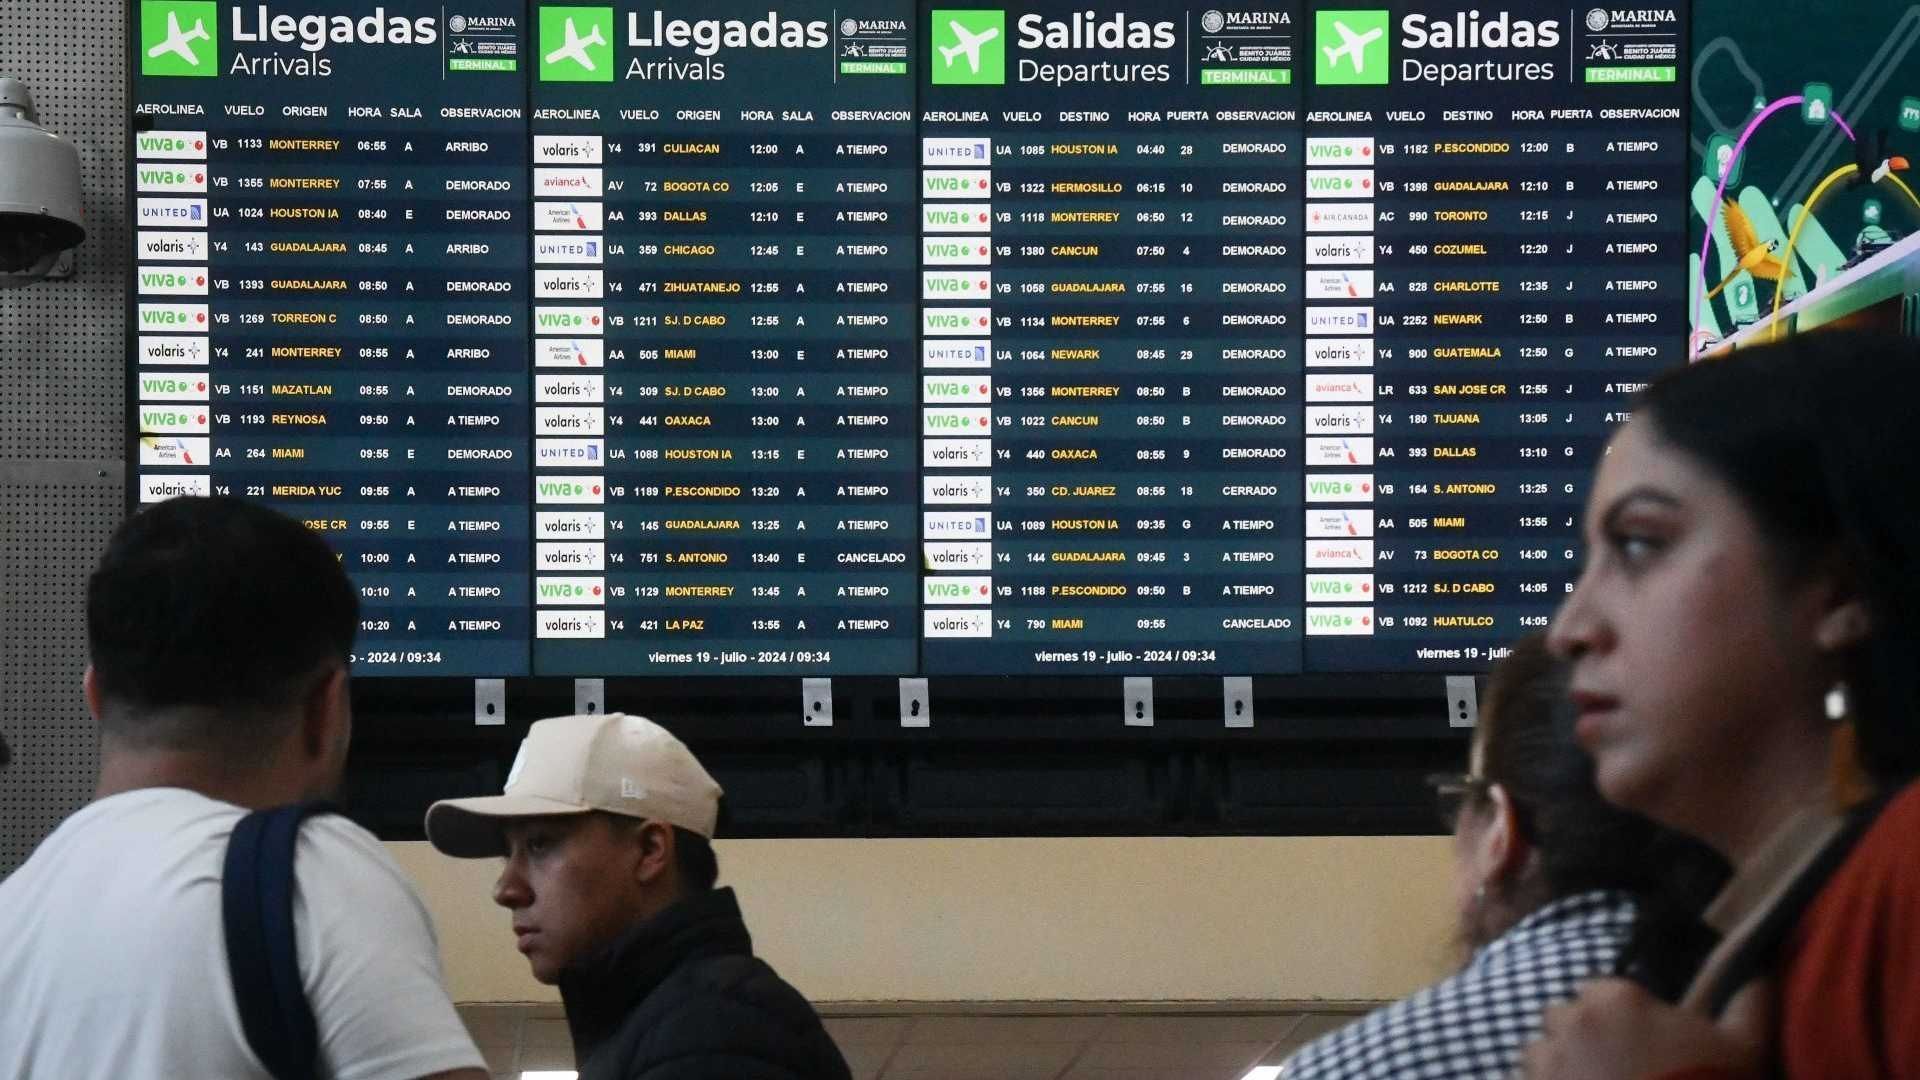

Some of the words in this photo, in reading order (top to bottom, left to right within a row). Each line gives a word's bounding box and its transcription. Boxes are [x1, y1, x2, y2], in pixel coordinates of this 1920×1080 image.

[468, 17, 516, 27] MARINA
[1226, 12, 1291, 24] MARINA
[1611, 10, 1676, 22] MARINA
[231, 4, 437, 52] Llegadas
[859, 21, 906, 30] MARINA
[1017, 10, 1176, 50] Salidas
[1401, 8, 1560, 50] Salidas
[627, 11, 829, 57] Llegadas
[230, 52, 332, 77] Arrivals
[452, 60, 504, 69] TERMINAL
[625, 57, 725, 81] Arrivals
[844, 63, 896, 72] TERMINAL
[1018, 59, 1170, 87] Departures
[1205, 71, 1276, 82] TERMINAL
[1402, 58, 1554, 86] Departures
[1591, 69, 1661, 81] TERMINAL
[136, 104, 204, 116] AEROLINEA
[224, 105, 265, 116] VUELO
[282, 105, 328, 117] ORIGEN
[348, 106, 382, 118] HORA
[390, 106, 422, 119] SALA
[440, 107, 521, 119] OBSERVACION
[533, 109, 600, 120] AEROLINEA
[619, 109, 659, 121] VUELO
[676, 109, 721, 121] ORIGEN
[741, 110, 774, 121] HORA
[782, 110, 814, 122] SALA
[831, 110, 911, 122] OBSERVACION
[922, 111, 989, 123] AEROLINEA
[1002, 111, 1042, 123] VUELO
[1059, 111, 1110, 123] DESTINO
[1128, 111, 1161, 123] HORA
[1167, 111, 1209, 122] PUERTA
[1215, 110, 1296, 122] OBSERVACION
[1306, 110, 1373, 122] AEROLINEA
[1386, 110, 1425, 122] VUELO
[1443, 110, 1493, 121] DESTINO
[1511, 110, 1545, 121] HORA
[1550, 109, 1593, 120] PUERTA
[1600, 108, 1680, 120] OBSERVACION
[543, 175, 581, 187] avianca
[607, 180, 624, 192] AV
[644, 181, 657, 193] 72
[663, 181, 711, 193] BOGOTA
[712, 181, 730, 193] CO
[750, 182, 779, 193] 12:05
[796, 182, 804, 193] E
[836, 182, 846, 193] A
[846, 182, 888, 193] TIEMPO
[142, 207, 188, 218] UNITED
[213, 207, 229, 218] UA
[238, 208, 264, 219] 1024
[269, 208, 326, 219] HOUSTON
[328, 208, 339, 219] IA
[358, 209, 387, 220] 08:40
[405, 209, 414, 220] E
[445, 209, 511, 221] DEMORADO
[608, 211, 624, 222] AA
[638, 211, 658, 222] 393
[663, 211, 707, 222] DALLAS
[750, 212, 779, 222] 12:10
[796, 212, 804, 222] E
[836, 211, 846, 222] A
[846, 211, 888, 222] TIEMPO
[1379, 211, 1395, 222] AC
[1408, 211, 1428, 222] 990
[1434, 210, 1488, 222] TORONTO
[1520, 210, 1549, 222] 12:15
[1566, 210, 1574, 221] J
[1605, 213, 1616, 224] A
[1616, 212, 1658, 224] TIEMPO
[995, 246, 1012, 257] VB
[1020, 246, 1045, 257] 1380
[1051, 245, 1099, 257] CANCUN
[1136, 246, 1165, 257] 07:50
[1183, 246, 1190, 257] 4
[1222, 245, 1287, 257] DEMORADO
[1315, 347, 1351, 361] volaris
[1378, 349, 1393, 360] Y4
[1408, 348, 1428, 360] 900
[1433, 348, 1502, 359] GUATEMALA
[1519, 347, 1548, 359] 12:50
[1564, 348, 1574, 359] G
[1605, 347, 1615, 358] A
[1615, 346, 1657, 357] TIEMPO
[215, 414, 231, 425] VB
[240, 414, 266, 425] 1193
[271, 414, 327, 426] REYNOSA
[360, 414, 389, 426] 09:50
[406, 415, 415, 426] A
[447, 415, 457, 426] A
[458, 415, 500, 426] TIEMPO
[932, 483, 968, 497] volaris
[996, 486, 1011, 497] Y4
[1026, 486, 1045, 497] 350
[1051, 486, 1071, 497] CD.
[1073, 486, 1116, 497] JUAREZ
[1137, 486, 1166, 497] 08:55
[1180, 486, 1193, 497] 18
[1222, 485, 1277, 497] CERRADO
[545, 550, 581, 564] volaris
[610, 553, 624, 564] Y4
[640, 553, 659, 564] 751
[665, 552, 676, 564] S.
[678, 552, 728, 564] ANTONIO
[751, 553, 780, 564] 13:40
[797, 553, 805, 564] E
[837, 552, 906, 564] CANCELADO
[1379, 583, 1395, 594] VB
[1403, 583, 1428, 594] 1212
[1433, 583, 1450, 594] SJ.
[1452, 583, 1461, 594] D
[1463, 583, 1495, 594] CABO
[1519, 582, 1548, 594] 14:05
[1565, 583, 1574, 593] B
[361, 620, 390, 631] 10:20
[407, 620, 417, 631] A
[448, 620, 458, 631] A
[459, 620, 501, 631] TIEMPO
[367, 651, 397, 664] 2024
[407, 651, 442, 664] 09:34
[648, 652, 694, 664] viernes
[696, 651, 711, 663] 19
[720, 651, 748, 665] julio
[757, 651, 787, 664] 2024
[796, 651, 831, 664] 09:34
[1416, 647, 1461, 659] viernes
[1464, 647, 1478, 659] 19
